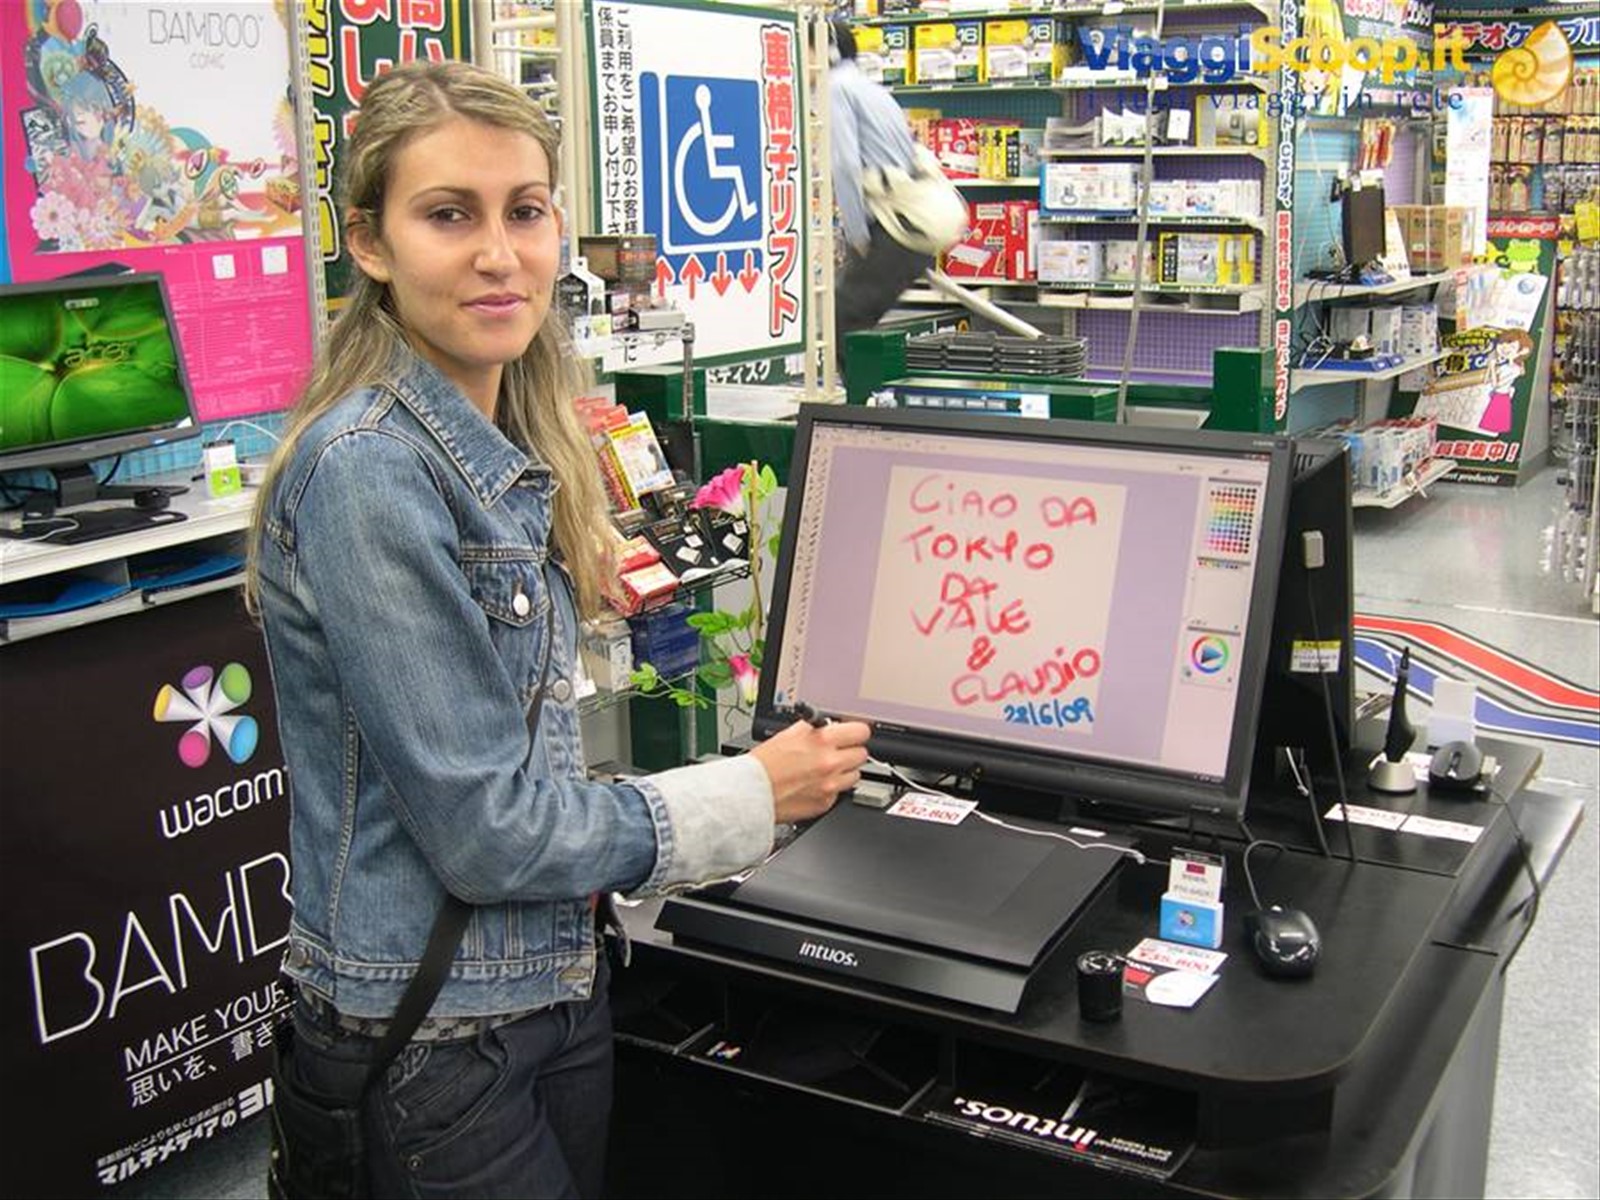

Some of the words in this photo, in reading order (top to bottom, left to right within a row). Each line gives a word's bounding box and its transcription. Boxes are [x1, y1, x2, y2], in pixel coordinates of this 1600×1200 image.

[148, 9, 260, 49] BAMBOO
[762, 28, 798, 336] 車椅子リフト
[1040, 496, 1097, 528] DA
[903, 525, 1054, 570] TOKYO
[940, 572, 998, 602] DA
[910, 599, 1031, 636] VALE
[967, 636, 996, 671] &
[160, 768, 284, 838] wacom
[124, 1014, 210, 1073] MAKE
